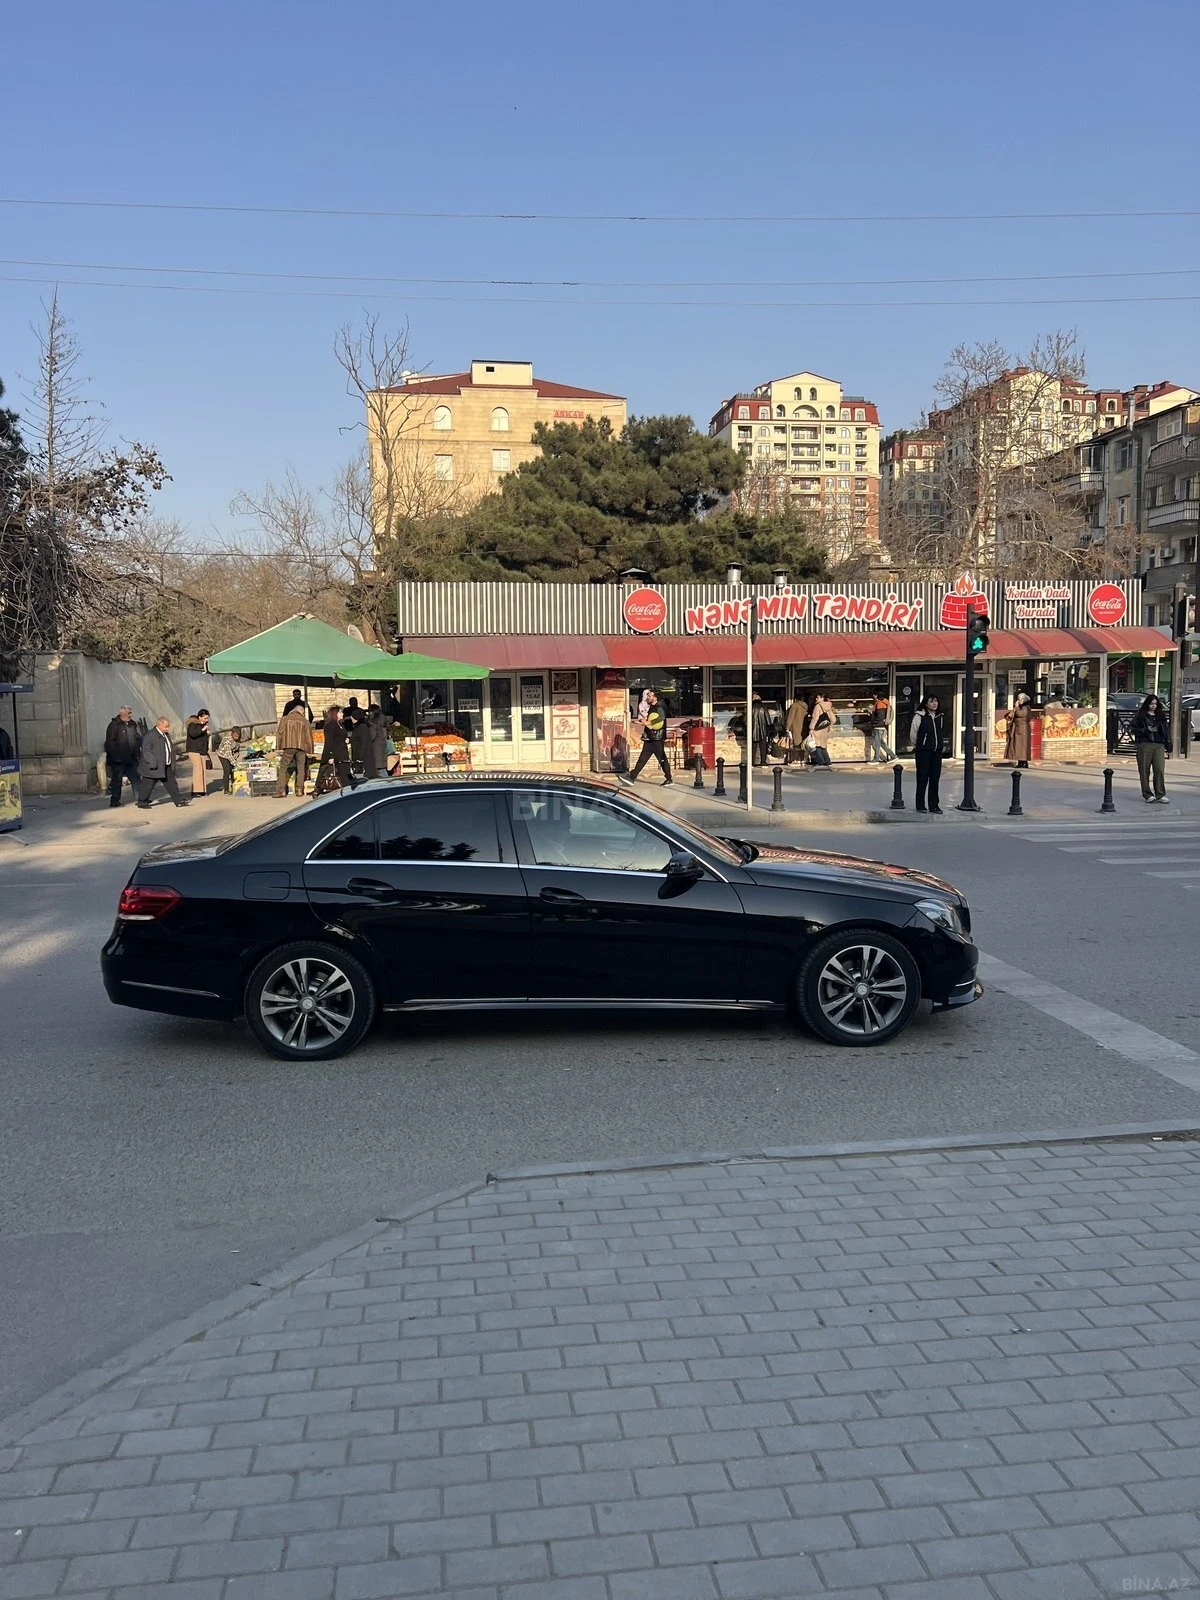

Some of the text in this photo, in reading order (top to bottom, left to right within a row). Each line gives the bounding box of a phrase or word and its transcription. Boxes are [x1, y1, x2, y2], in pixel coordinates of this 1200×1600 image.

[1006, 586, 1071, 599] Kəndin Dadı
[1016, 605, 1056, 617] Burada
